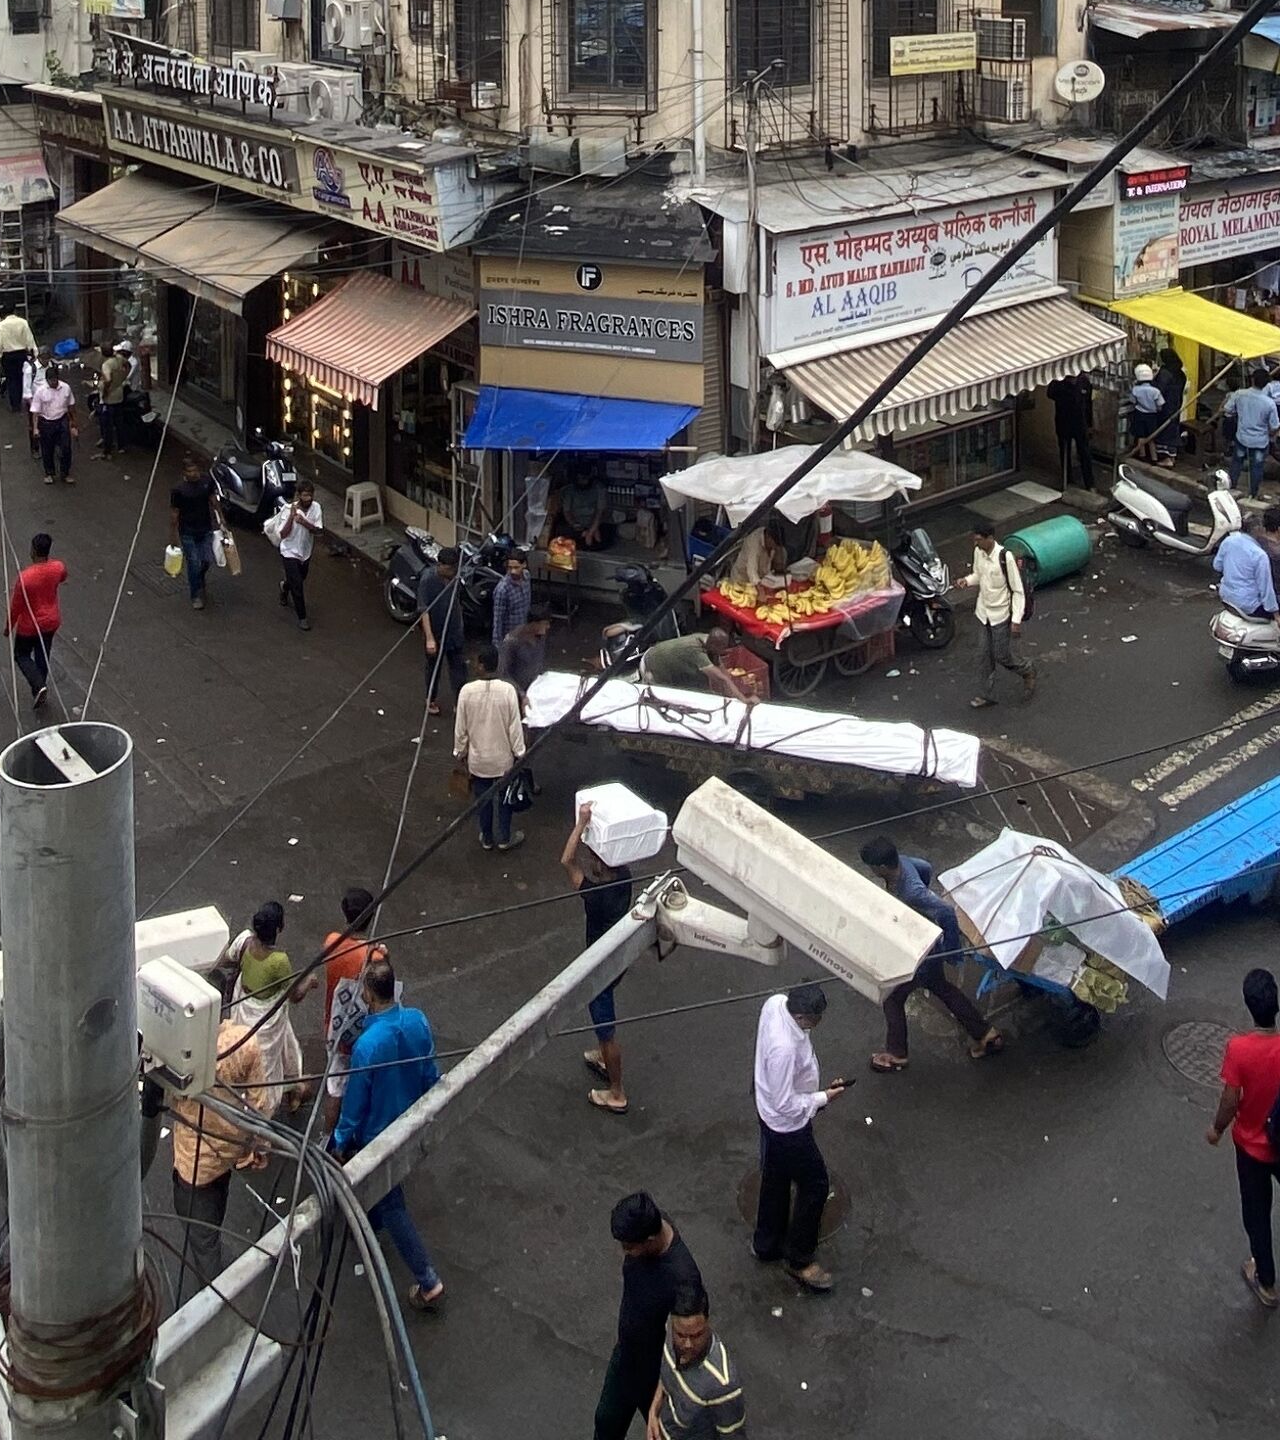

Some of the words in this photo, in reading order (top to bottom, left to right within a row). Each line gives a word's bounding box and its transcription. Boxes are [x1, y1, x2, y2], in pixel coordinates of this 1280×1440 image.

[143, 116, 239, 175] ATTARWALA
[240, 142, 257, 179] &
[258, 146, 288, 189] CO.
[834, 229, 893, 261] मोहम्मद
[943, 211, 986, 240] मलिक
[989, 196, 1037, 231] कन्नौजी
[1180, 222, 1218, 246] ROYAL
[799, 278, 818, 295] MD.
[820, 272, 844, 292] AYUB
[847, 265, 877, 285] MALIK
[879, 255, 926, 278] KANNAUJI
[811, 294, 836, 319] AL
[842, 280, 898, 312] AAQIB
[487, 304, 551, 330] ISHRA
[556, 309, 696, 344] FRAGRANCES
[808, 943, 854, 981] Infinova
